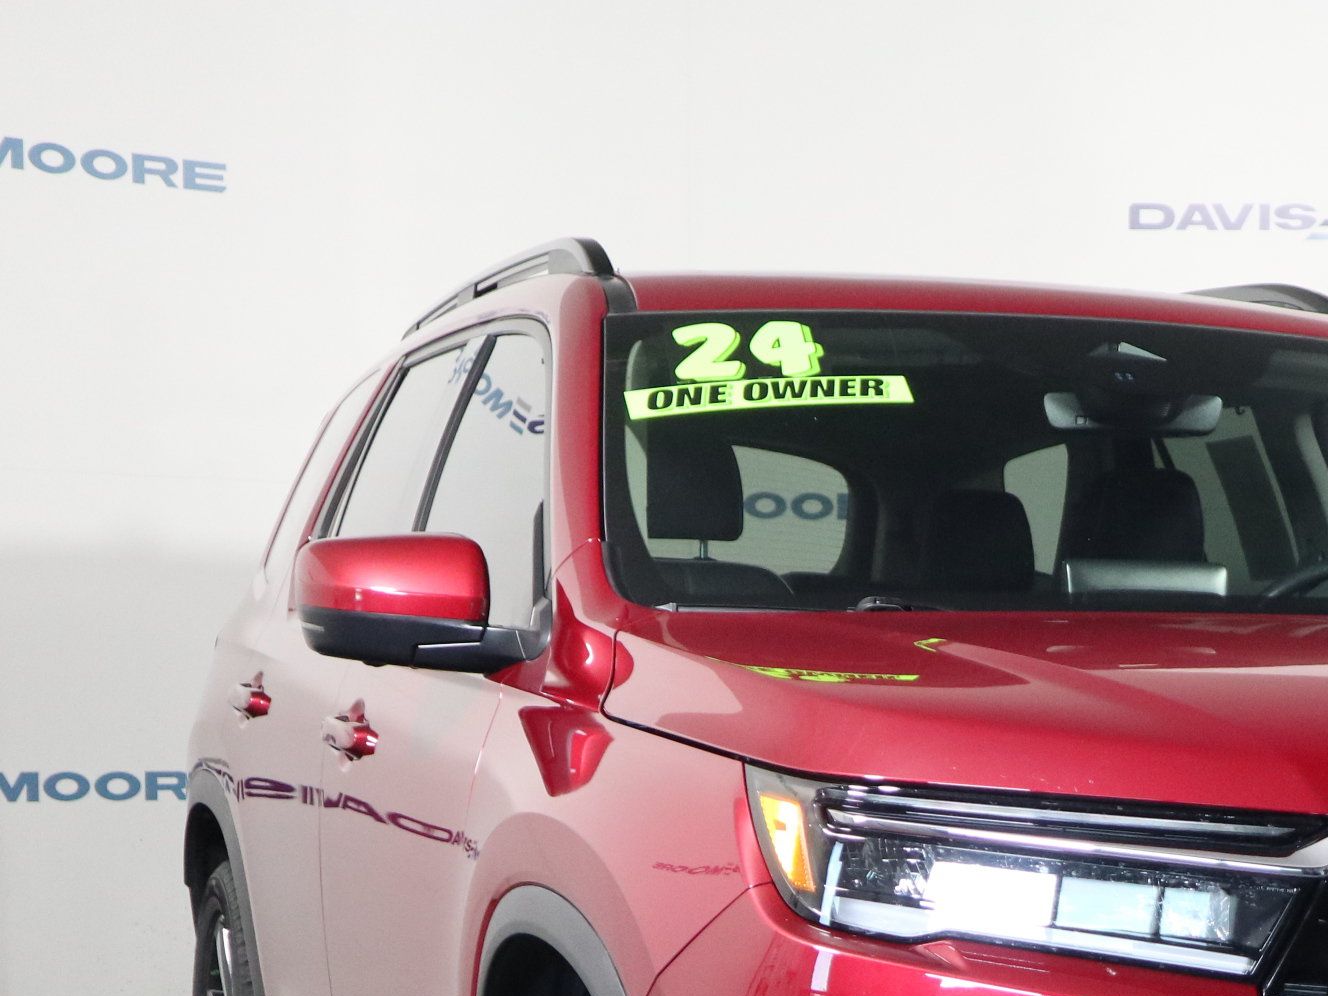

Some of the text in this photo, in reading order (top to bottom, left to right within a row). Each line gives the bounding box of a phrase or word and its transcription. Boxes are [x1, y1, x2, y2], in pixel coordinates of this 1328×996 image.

[1128, 203, 1317, 231] DAVIS
[671, 320, 825, 381] 24
[647, 378, 884, 411] ONE OWNER
[0, 770, 188, 802] MOOR
